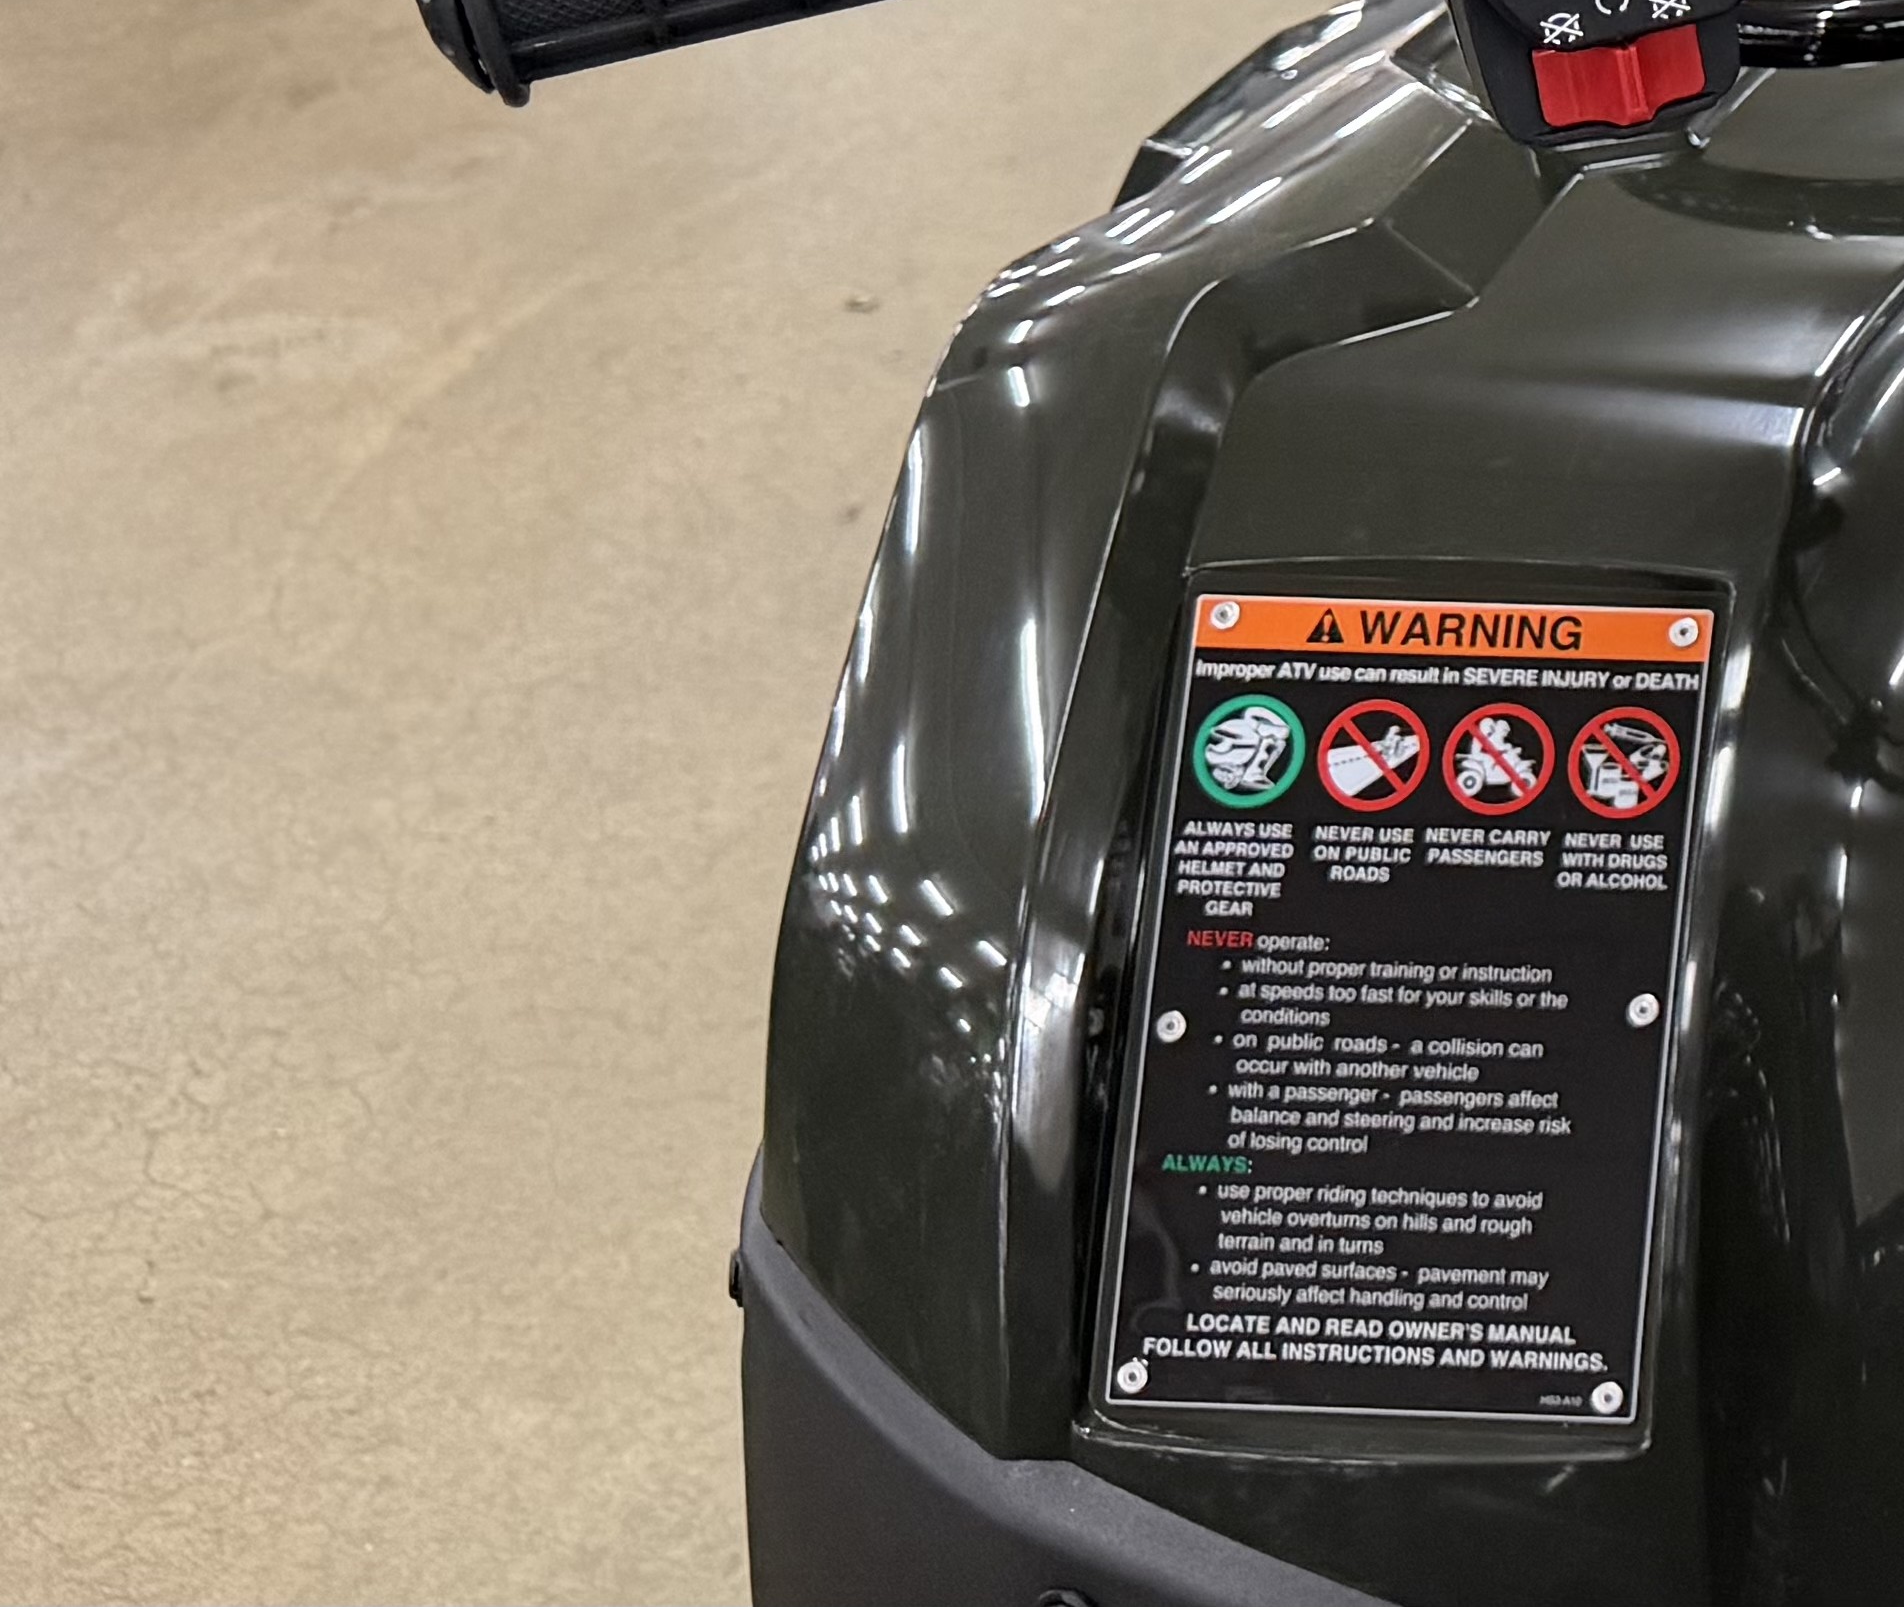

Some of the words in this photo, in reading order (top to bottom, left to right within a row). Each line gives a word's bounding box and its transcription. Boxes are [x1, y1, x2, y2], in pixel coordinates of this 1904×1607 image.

[1361, 611, 1582, 651] WARNING
[1196, 659, 1276, 681] Improper
[1277, 662, 1317, 679] ATV
[1319, 667, 1352, 681] use
[1354, 668, 1387, 682] can
[1389, 667, 1440, 683] result
[1442, 667, 1460, 684] in
[1463, 667, 1539, 686] SEVERE
[1541, 670, 1610, 688] INJURY
[1612, 675, 1632, 689] or
[1635, 672, 1699, 690] DEATH
[1184, 821, 1255, 837] ALWAYS
[1259, 823, 1292, 838] USE
[1315, 826, 1374, 841] NEVER
[1379, 828, 1414, 843] USE
[1426, 828, 1485, 844] NEVER
[1489, 829, 1551, 845] CARRY
[1174, 840, 1199, 854] AN
[1202, 841, 1294, 858] APPROVED
[1565, 833, 1621, 848] NEVER
[1630, 834, 1664, 850] USE
[1314, 845, 1340, 860] ON
[1345, 846, 1411, 863] PUBLIC
[1428, 848, 1543, 866] PASSENGERS
[1562, 853, 1604, 867] WITH
[1608, 854, 1667, 870] DRUGS
[1178, 860, 1246, 876] HELMET
[1248, 862, 1285, 877] AND
[1330, 865, 1390, 882] ROADS
[1177, 879, 1281, 897] PROTECTIVE
[1557, 872, 1582, 887] OR
[1585, 873, 1667, 890] ALCOHOL
[1205, 900, 1253, 916] GEAR
[1188, 931, 1253, 947] NEVER
[1257, 935, 1330, 952] operate:
[1242, 957, 1304, 975] without
[1307, 962, 1366, 979] proper
[1370, 962, 1435, 983] training
[1439, 966, 1458, 980] or
[1462, 965, 1552, 983] instruction
[1187, 1313, 1270, 1334] LOCATE
[1275, 1317, 1320, 1335] AND
[1325, 1318, 1383, 1338] READ
[1388, 1320, 1483, 1341] OWNER'S
[1488, 1324, 1576, 1345] MANUAL
[1143, 1337, 1232, 1358] FOLLOW
[1236, 1341, 1276, 1359] ALL
[1282, 1342, 1435, 1365] INSTRUCTIONS
[1440, 1348, 1485, 1367] AND
[1490, 1350, 1608, 1371] WARNINGS.
